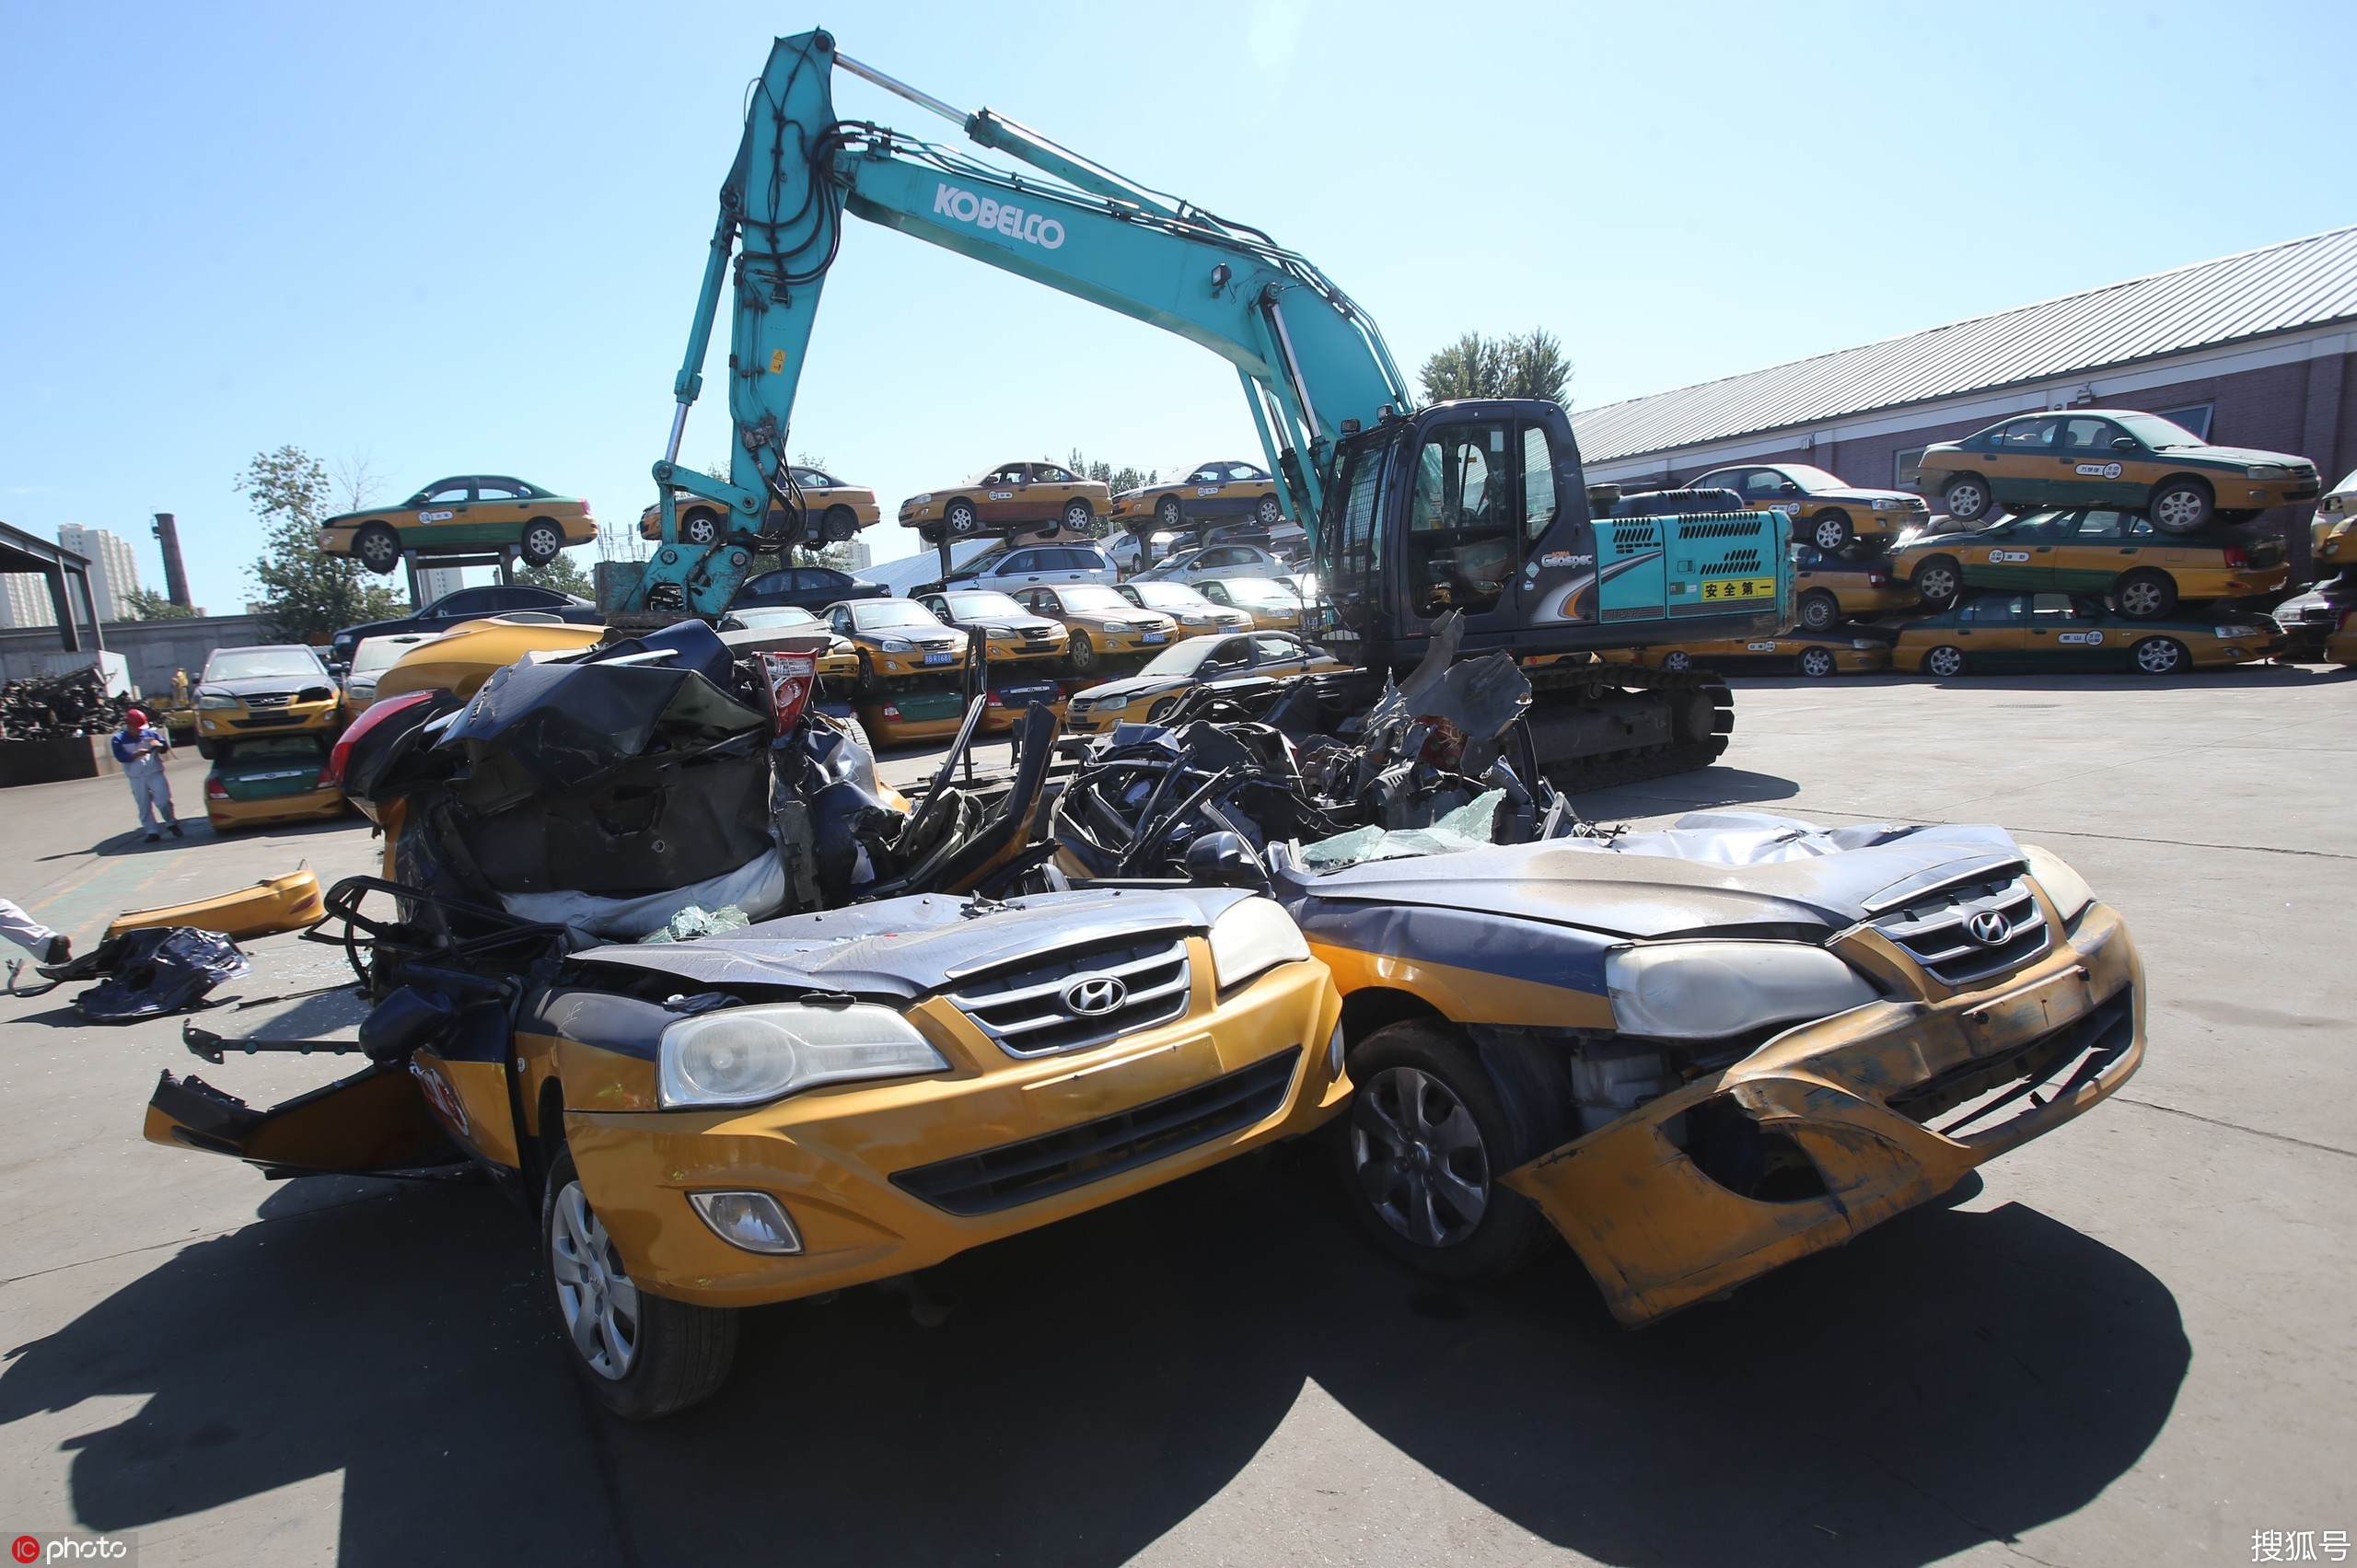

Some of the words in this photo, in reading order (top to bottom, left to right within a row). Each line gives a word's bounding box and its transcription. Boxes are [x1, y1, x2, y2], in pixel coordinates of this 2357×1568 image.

[933, 182, 1065, 250] KOBELCO
[1705, 581, 1771, 598] 安全第一
